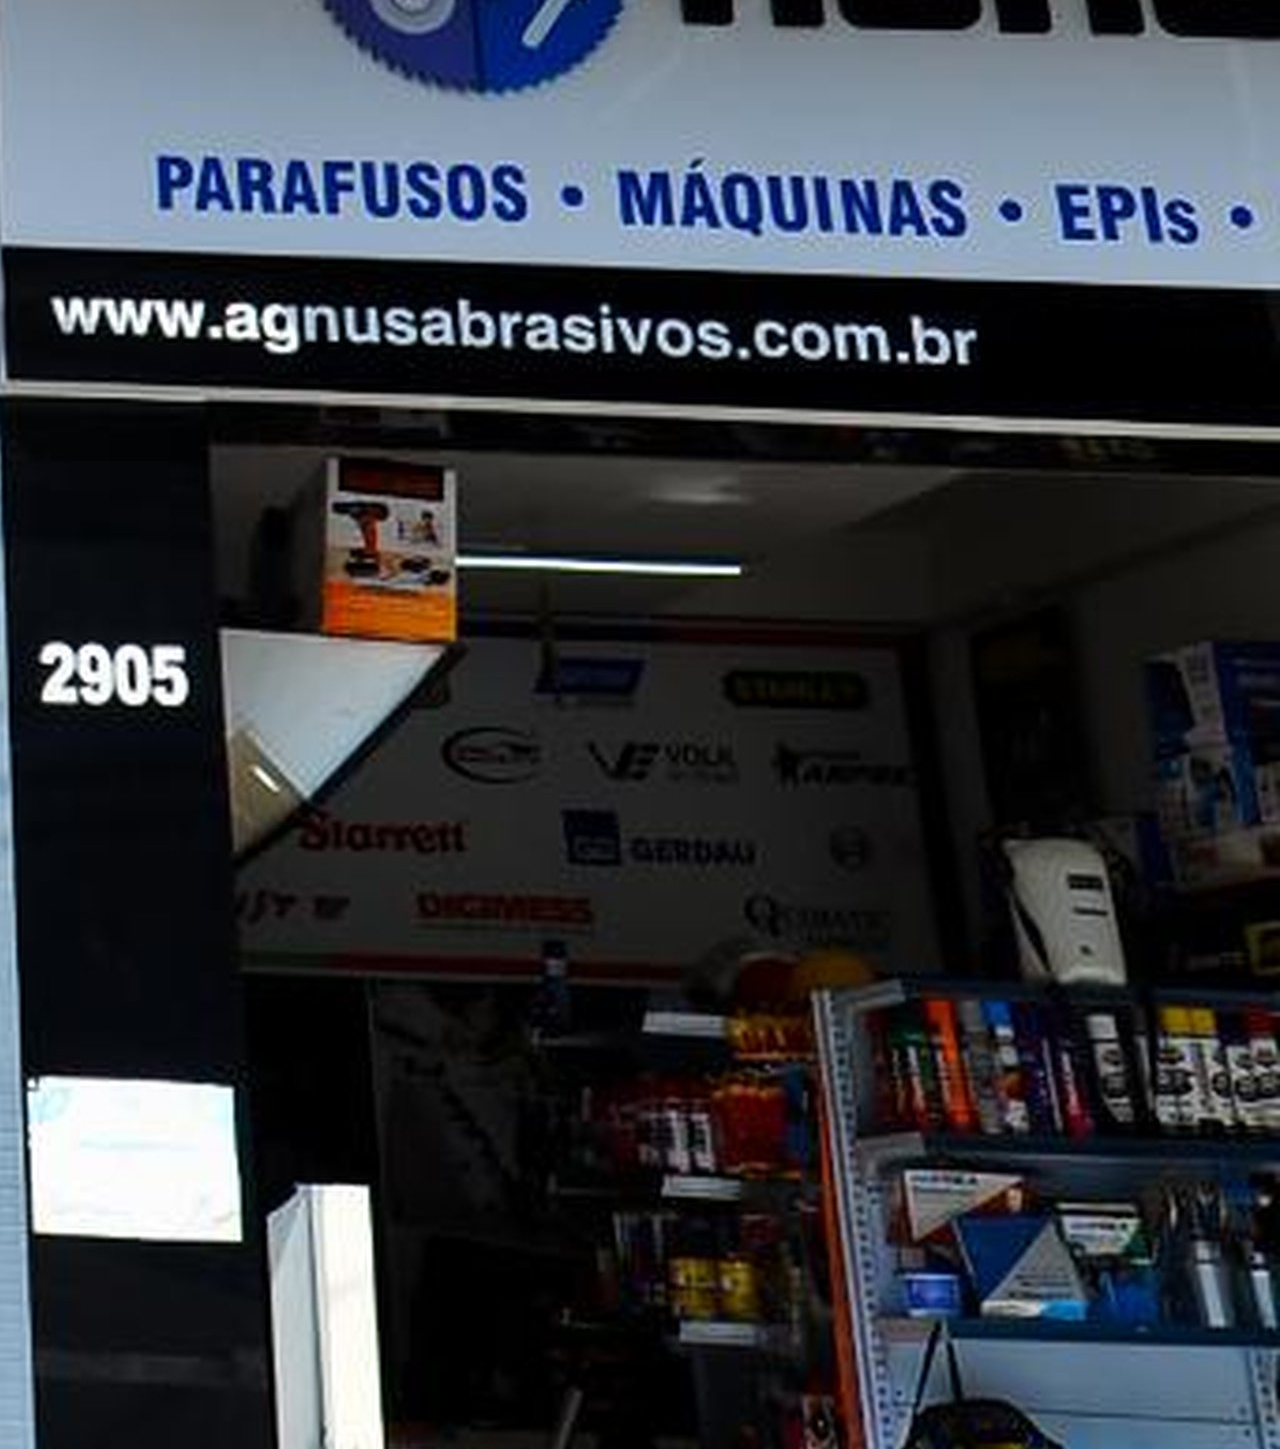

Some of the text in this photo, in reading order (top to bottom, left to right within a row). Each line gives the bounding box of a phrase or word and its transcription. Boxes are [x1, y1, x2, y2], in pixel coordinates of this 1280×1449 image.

[156, 155, 1200, 245] PARAFUSOS MÁQUINAS EPIs
[51, 293, 978, 366] www.agnusabrasivos.com.br
[40, 641, 189, 706] 2905
